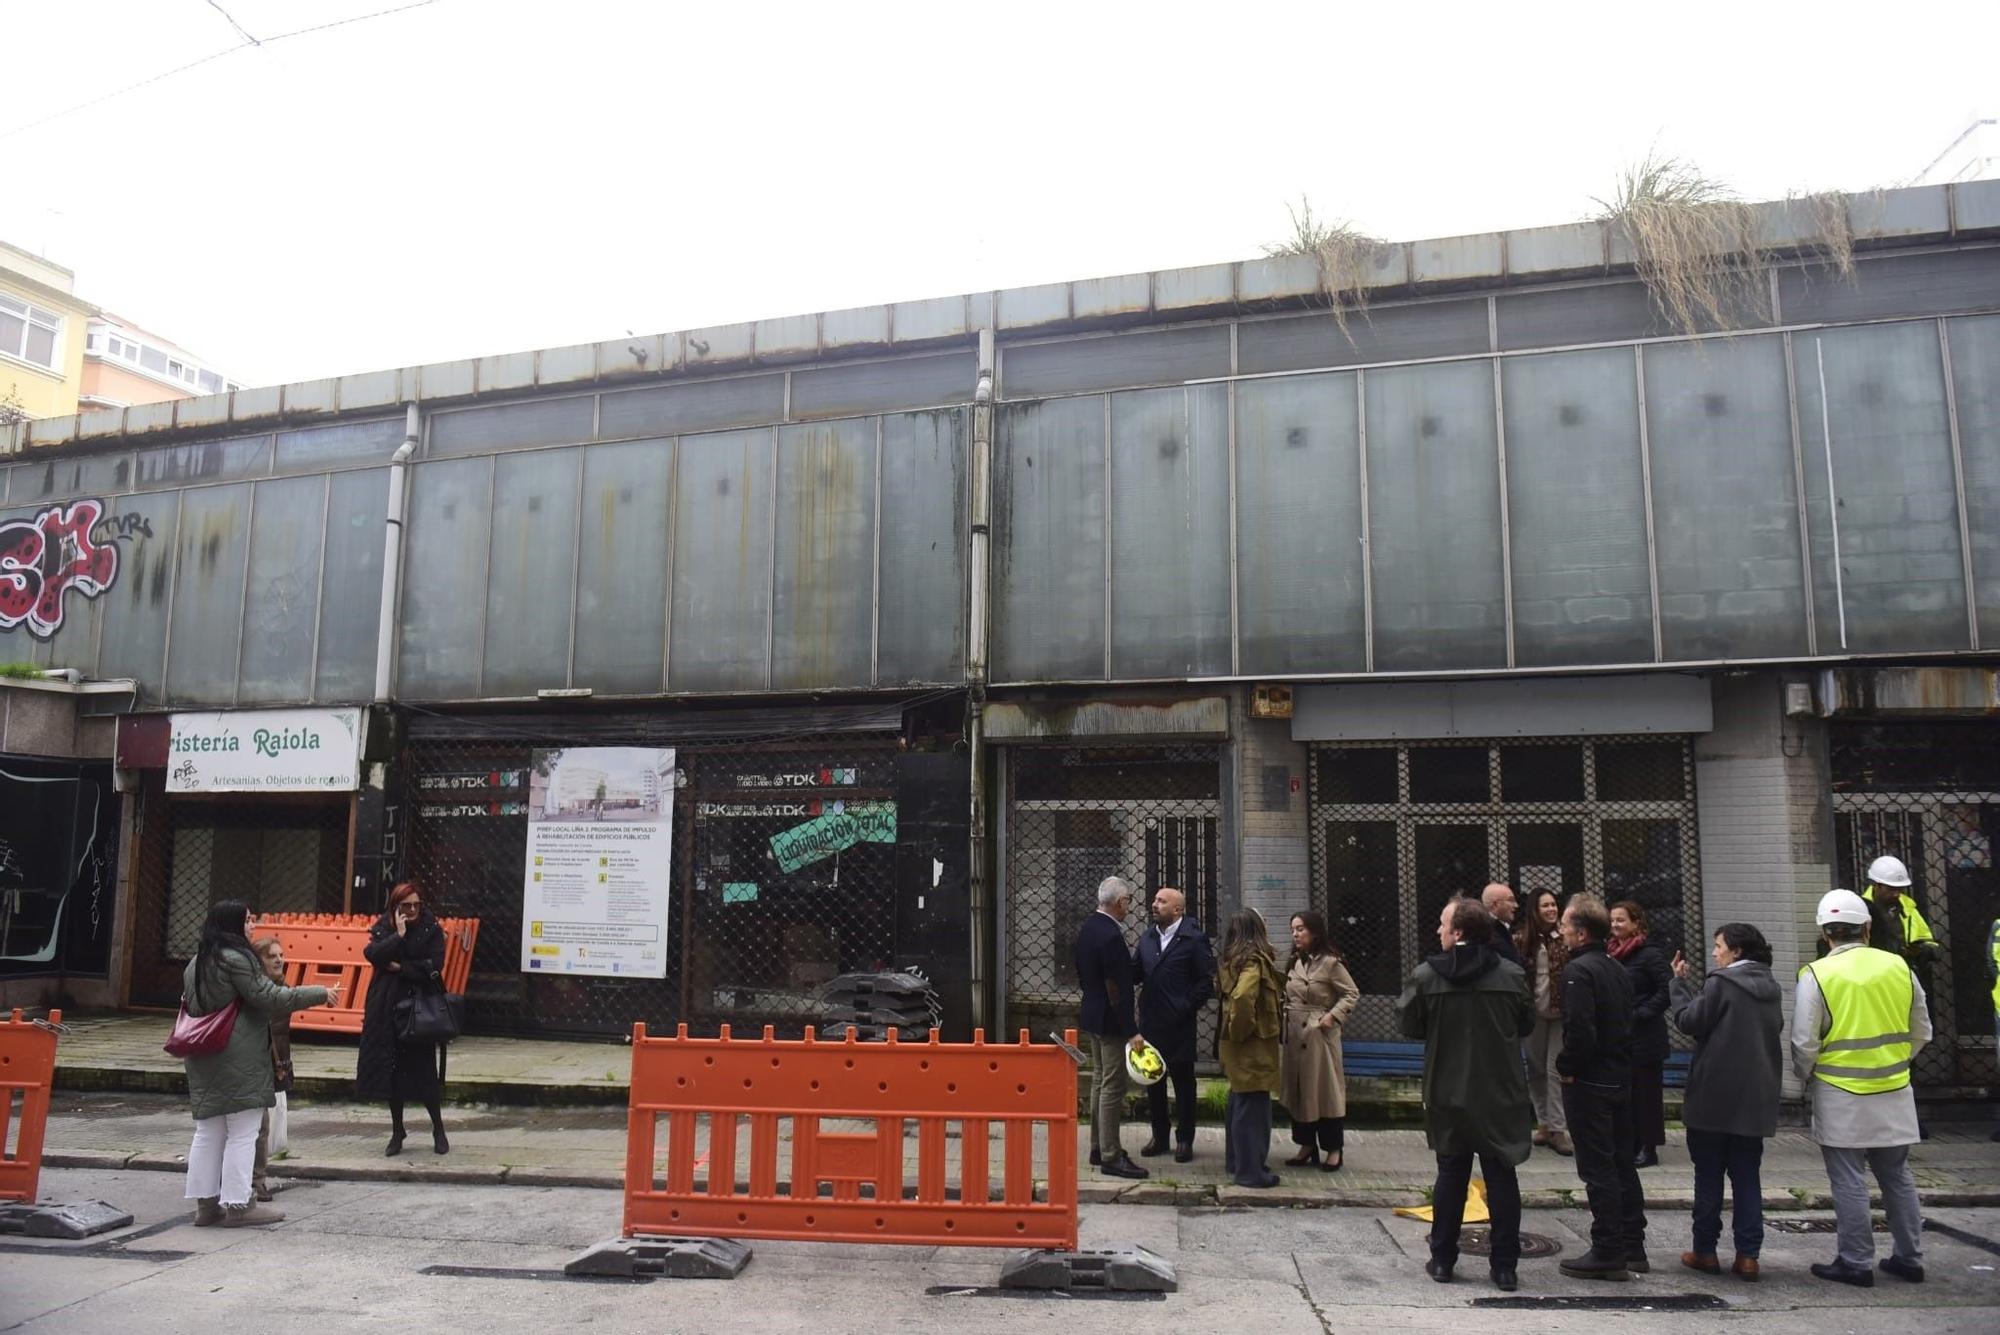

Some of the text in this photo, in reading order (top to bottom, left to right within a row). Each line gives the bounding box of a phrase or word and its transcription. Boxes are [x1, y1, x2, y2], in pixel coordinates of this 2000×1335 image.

[253, 727, 320, 758] Raiola
[266, 774, 302, 787] Objetos
[304, 774, 316, 785] de
[460, 777, 487, 788] TDK
[783, 774, 816, 786] TDK
[460, 805, 487, 816] TDK
[772, 804, 806, 816] TDK
[855, 815, 892, 832] TOTAL
